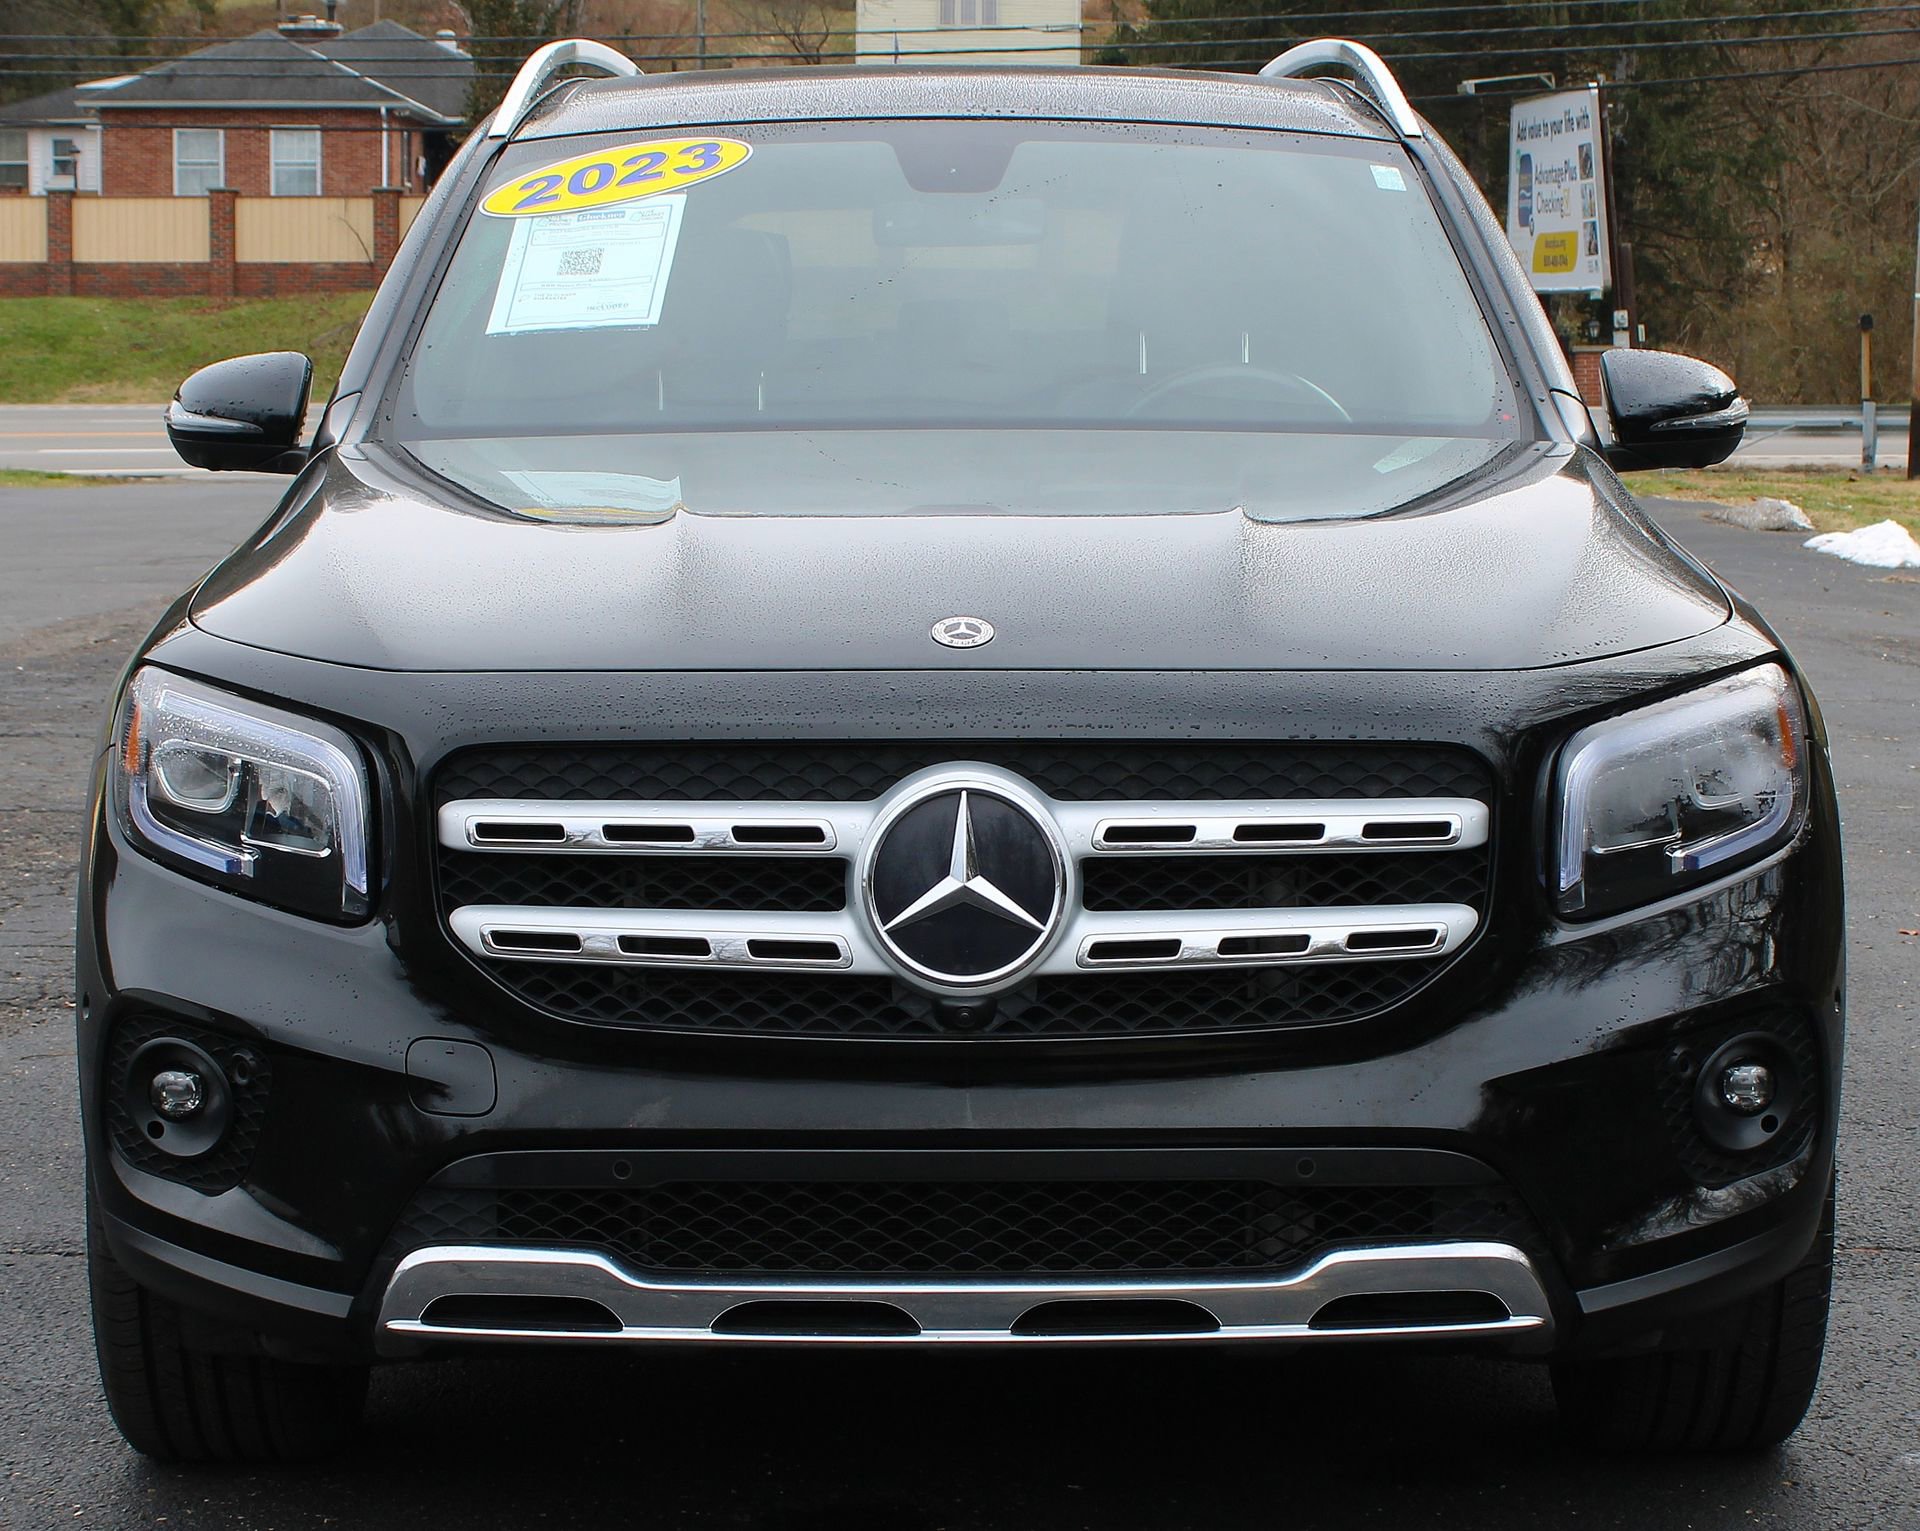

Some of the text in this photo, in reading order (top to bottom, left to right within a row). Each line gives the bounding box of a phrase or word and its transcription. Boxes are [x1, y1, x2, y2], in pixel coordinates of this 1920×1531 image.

[1516, 105, 1590, 143] Add value to your life with
[512, 142, 724, 212] 2023
[1536, 191, 1564, 218] Checking
